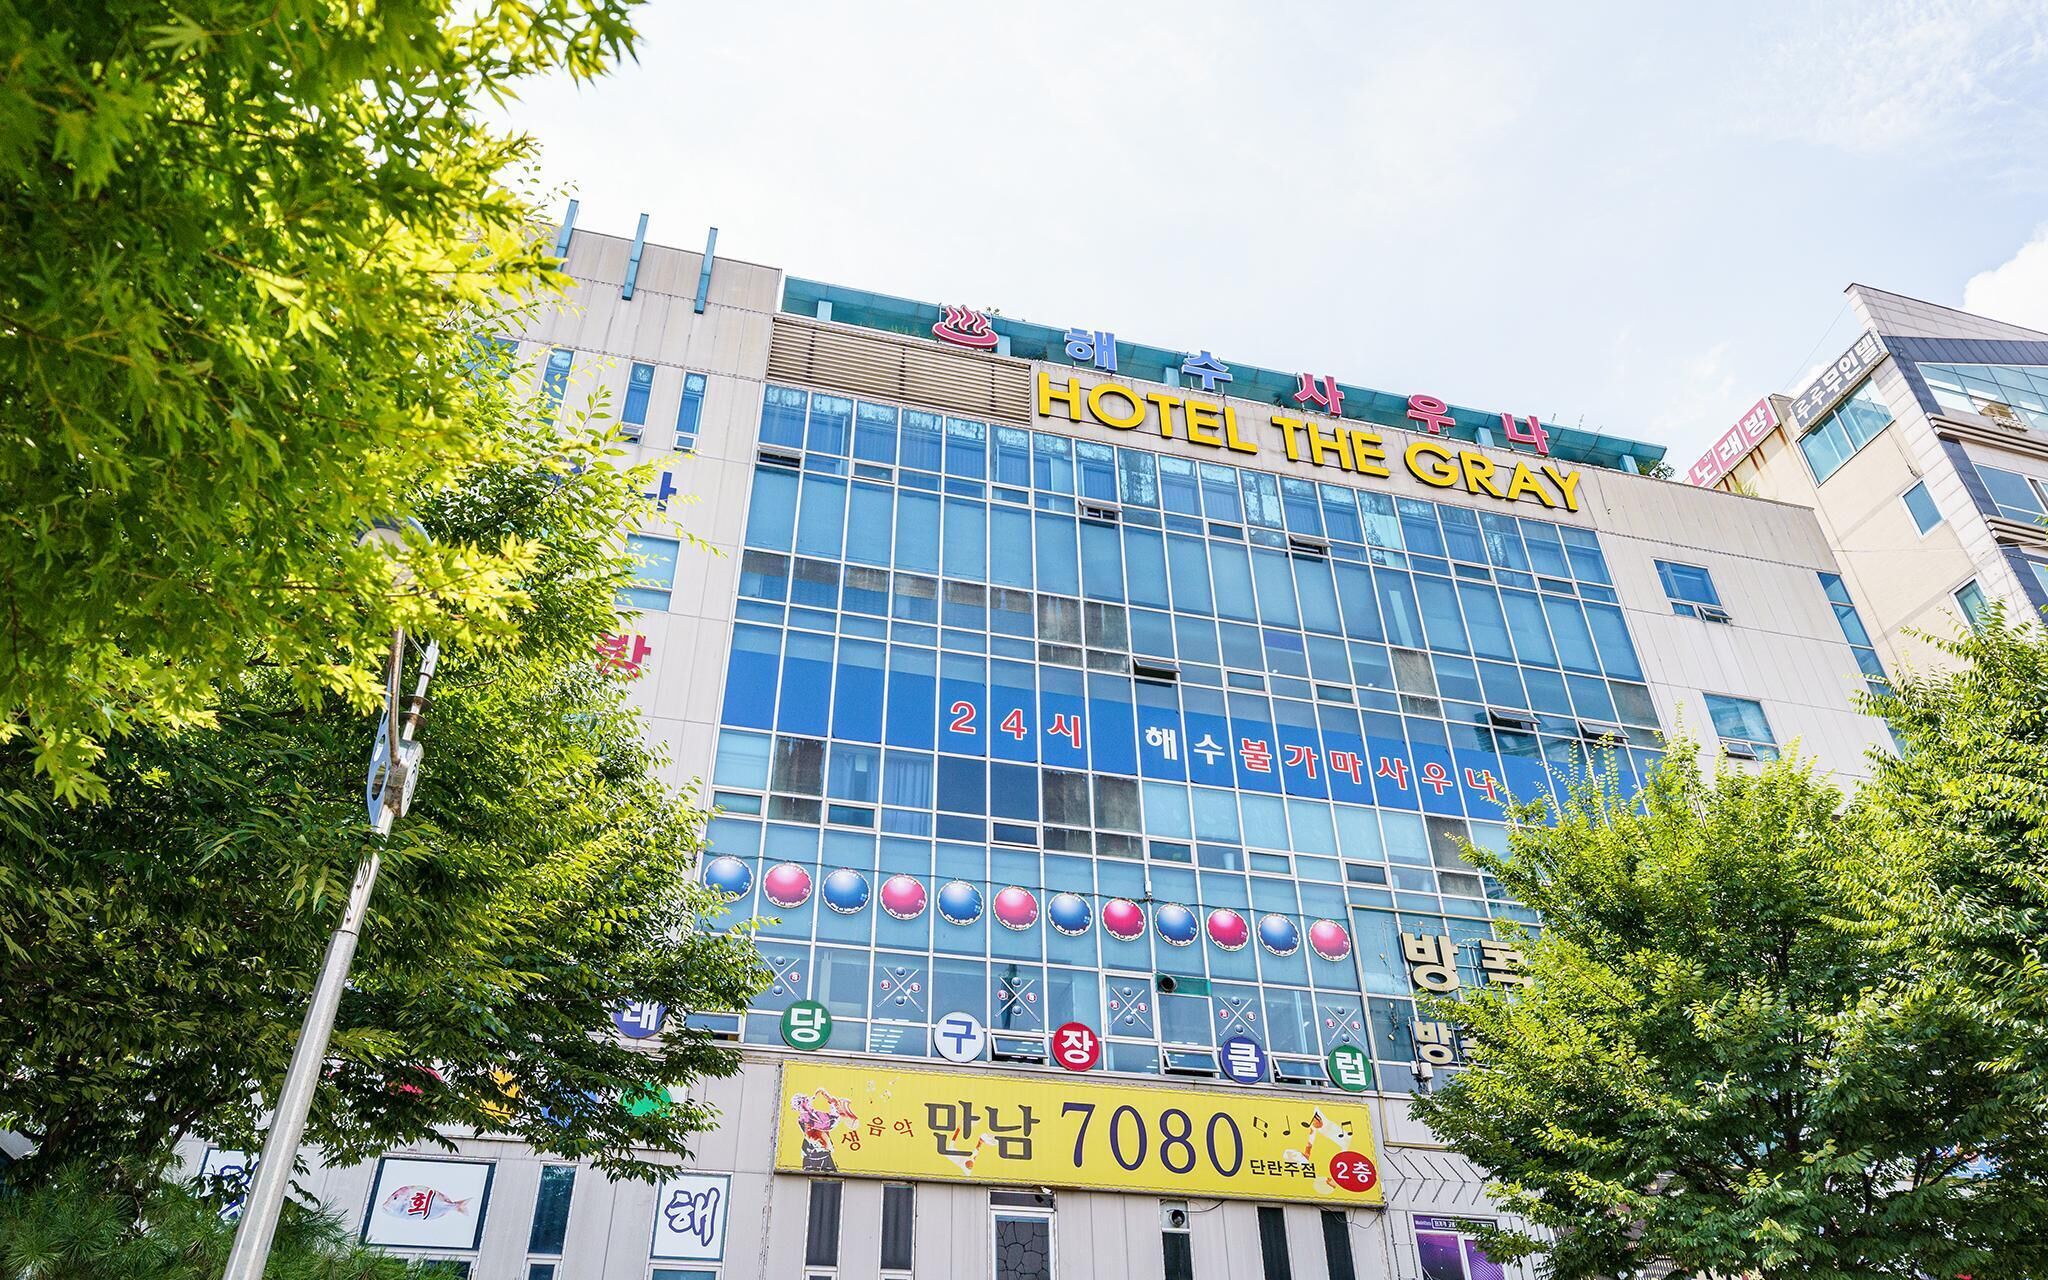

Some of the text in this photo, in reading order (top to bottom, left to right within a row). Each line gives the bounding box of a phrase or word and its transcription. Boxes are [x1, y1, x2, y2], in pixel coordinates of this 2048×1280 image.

[1037, 372, 1581, 512] HOTEL THE GRAY
[924, 1100, 1041, 1161] 만남
[1061, 1102, 1244, 1177] 7080
[1250, 1159, 1317, 1179] 단란주점
[1336, 1161, 1374, 1184] 2층
[408, 1189, 436, 1220] 회
[664, 1187, 720, 1247] 해
